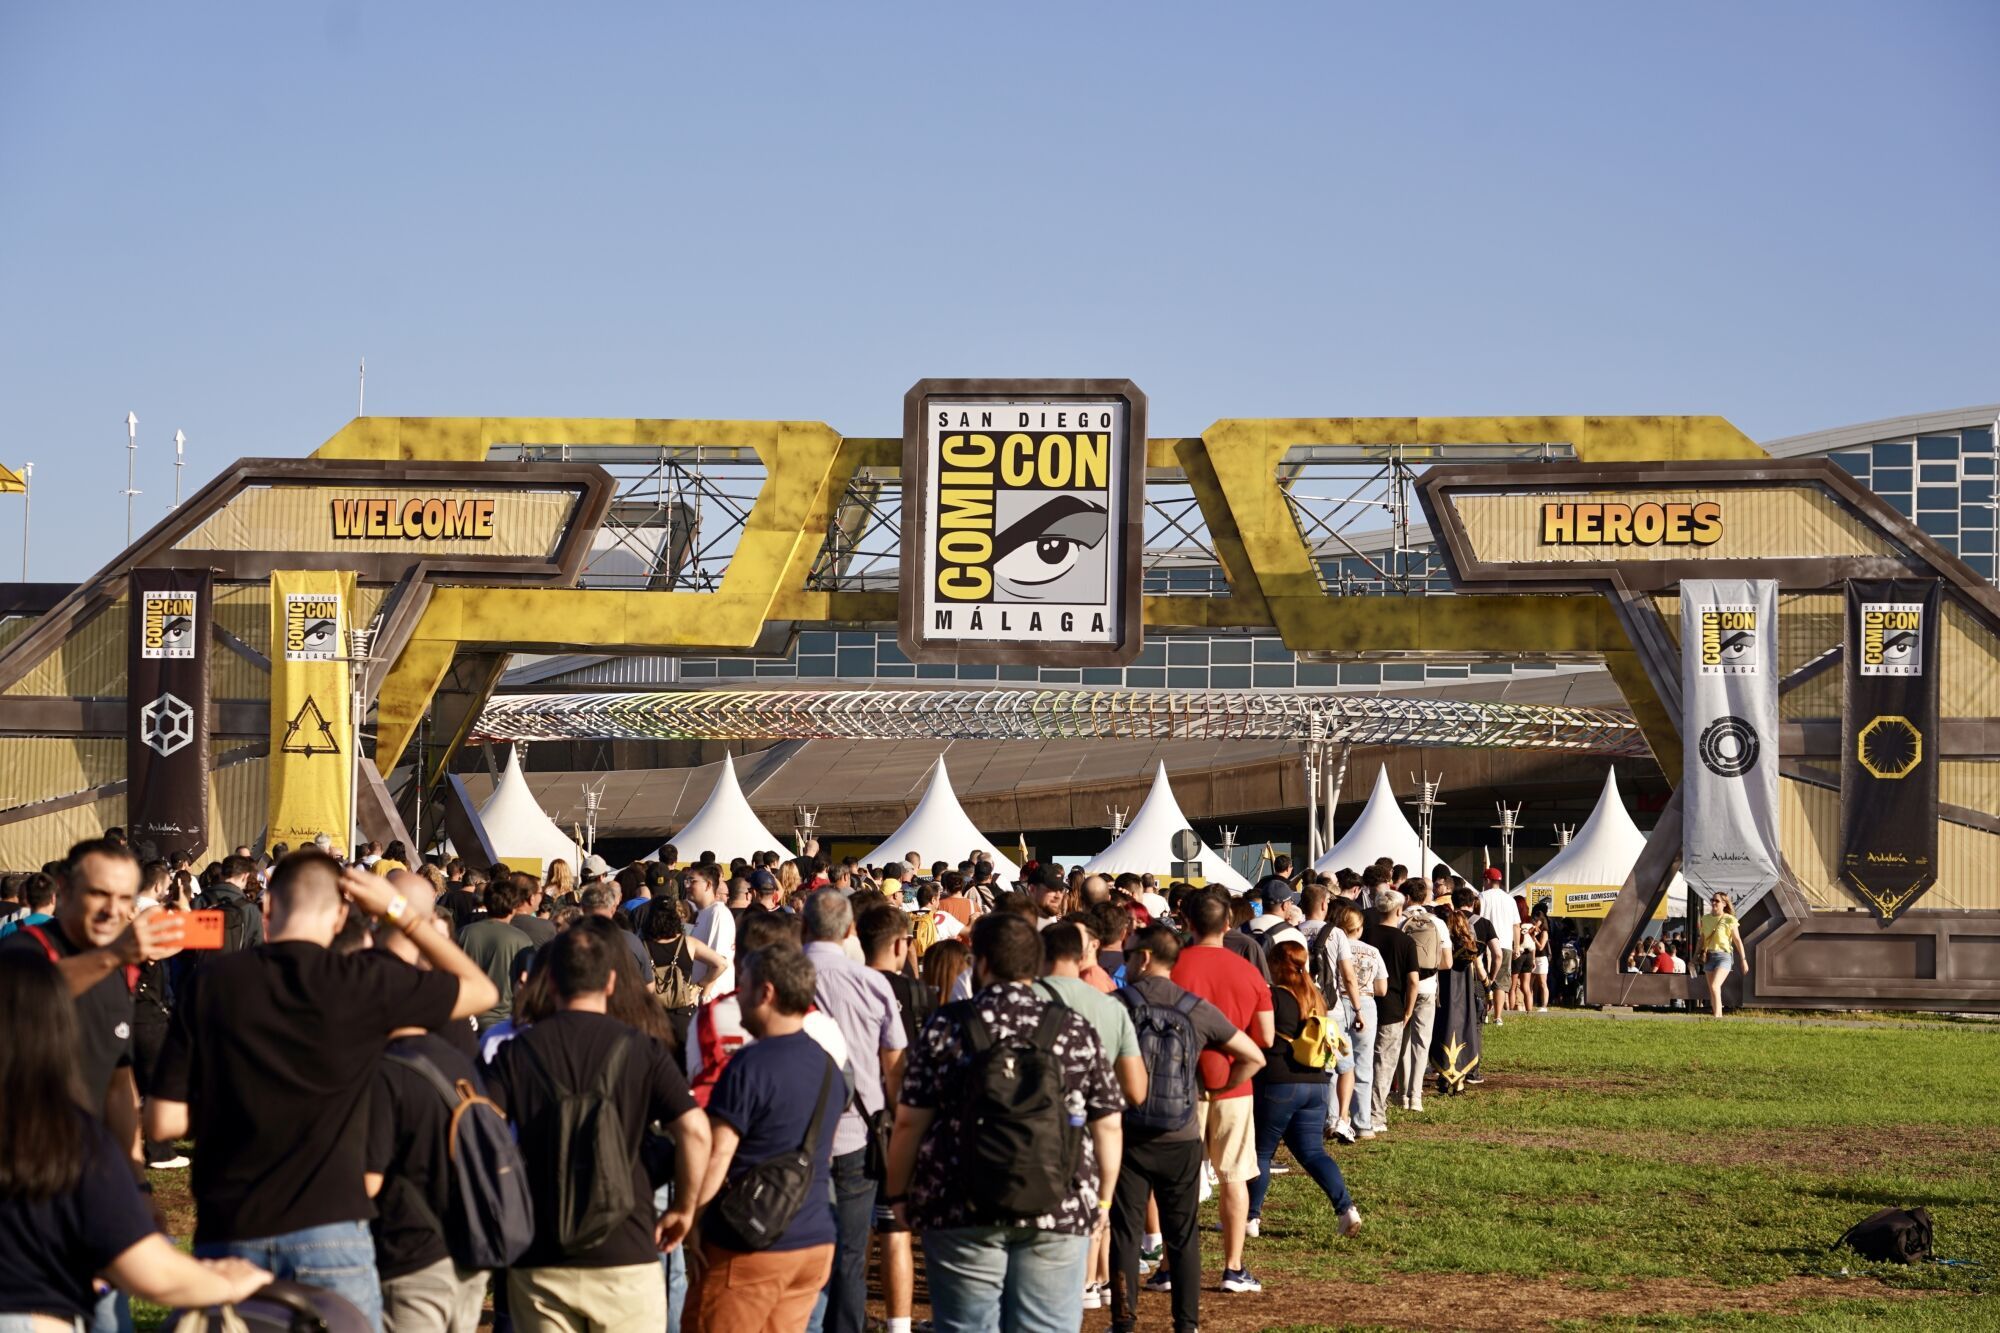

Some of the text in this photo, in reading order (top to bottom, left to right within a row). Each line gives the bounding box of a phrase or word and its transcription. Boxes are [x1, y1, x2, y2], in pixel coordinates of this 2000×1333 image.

[938, 411, 1111, 429] SAN DIEGO
[1000, 433, 1108, 488] CON
[332, 498, 495, 540] WELCOME
[938, 434, 996, 600] COMIC
[1542, 501, 1724, 546] HEROES
[146, 599, 163, 648] COMIC
[163, 599, 193, 615] CON
[305, 602, 336, 619] CON
[934, 605, 1104, 633] MÁLAGA
[1721, 612, 1755, 630] CON
[1884, 612, 1919, 630] CON
[287, 602, 306, 651] COMIC
[1703, 612, 1721, 665] COMIC
[1865, 612, 1884, 664] COMIC
[1539, 889, 1553, 897] CON
[1568, 891, 1618, 902] GENERAL ADMISSION
